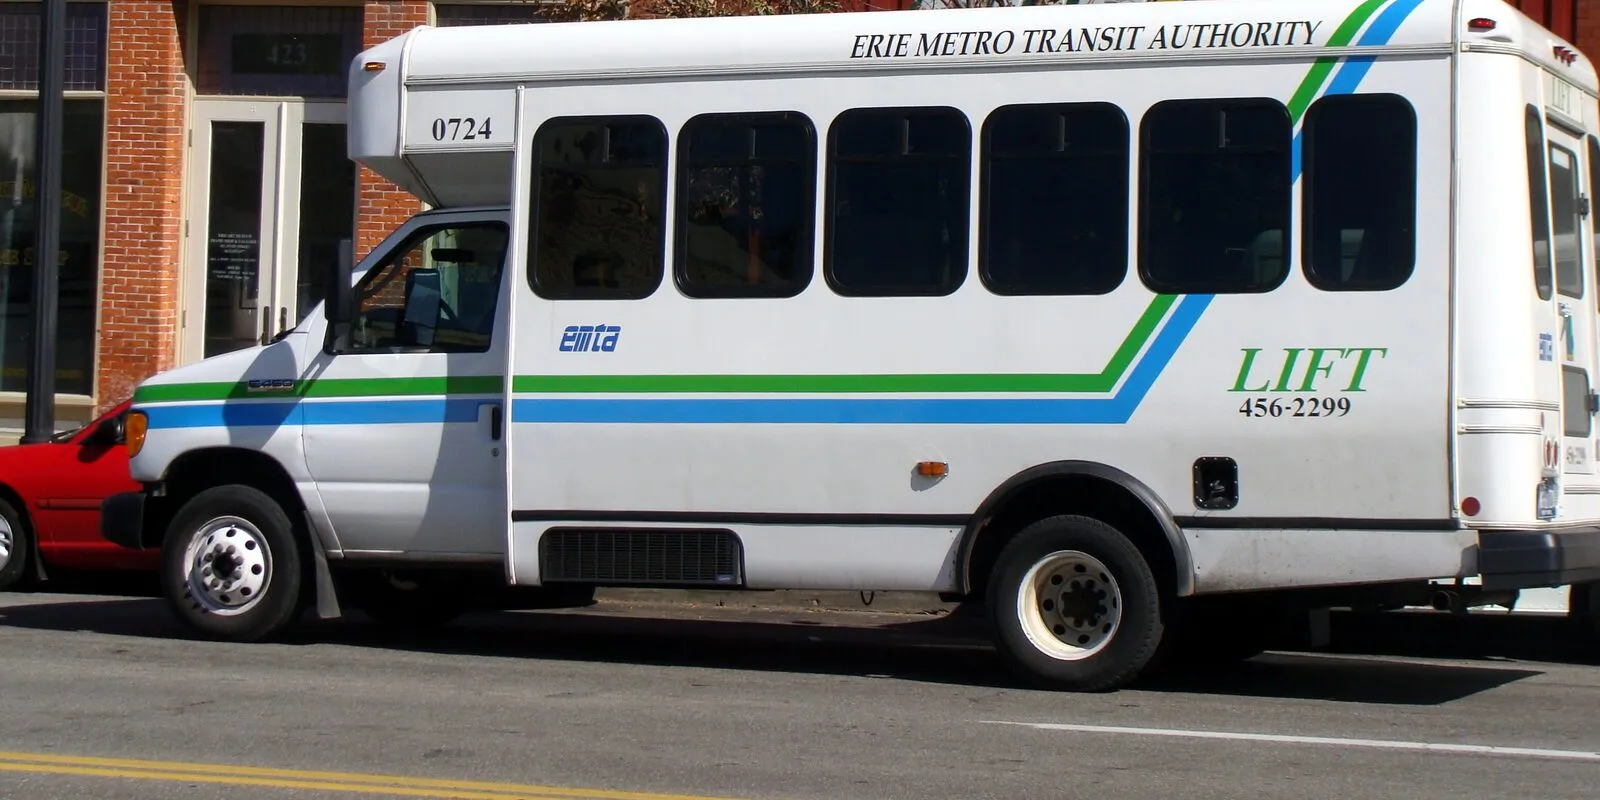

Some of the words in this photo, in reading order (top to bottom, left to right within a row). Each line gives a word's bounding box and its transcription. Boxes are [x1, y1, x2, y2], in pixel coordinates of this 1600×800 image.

[850, 34, 914, 60] ERIE
[915, 30, 1014, 58] METRO
[1022, 26, 1144, 55] TRANSIT
[1147, 20, 1323, 51] AUTHORITY
[265, 43, 307, 66] 423
[432, 116, 492, 142] 0724
[1227, 347, 1388, 392] LIFT
[1239, 397, 1351, 418] 456-2299
